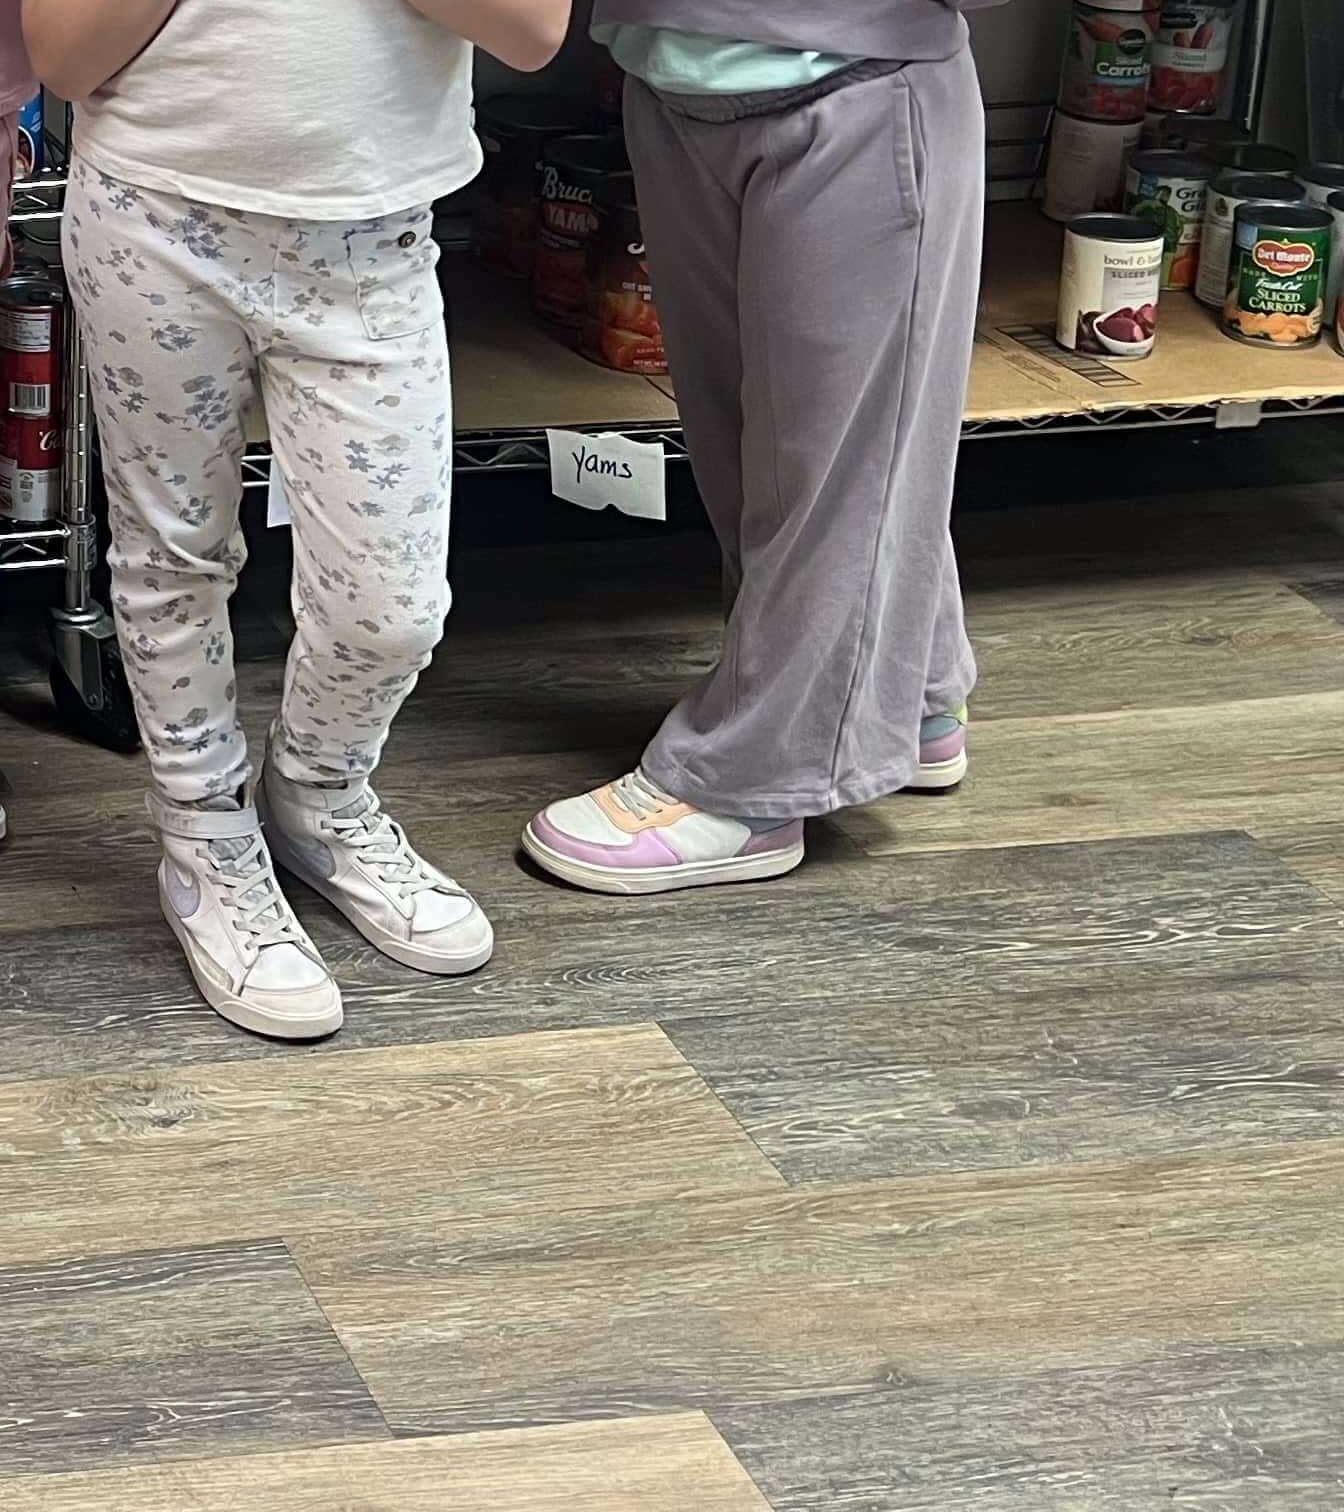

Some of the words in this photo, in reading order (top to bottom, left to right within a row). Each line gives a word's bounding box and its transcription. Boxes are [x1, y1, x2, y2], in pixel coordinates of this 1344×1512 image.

[1104, 255, 1134, 266] bowl
[1258, 289, 1300, 302] SLICED
[1249, 298, 1307, 313] CARROTS
[571, 446, 633, 483] yams
